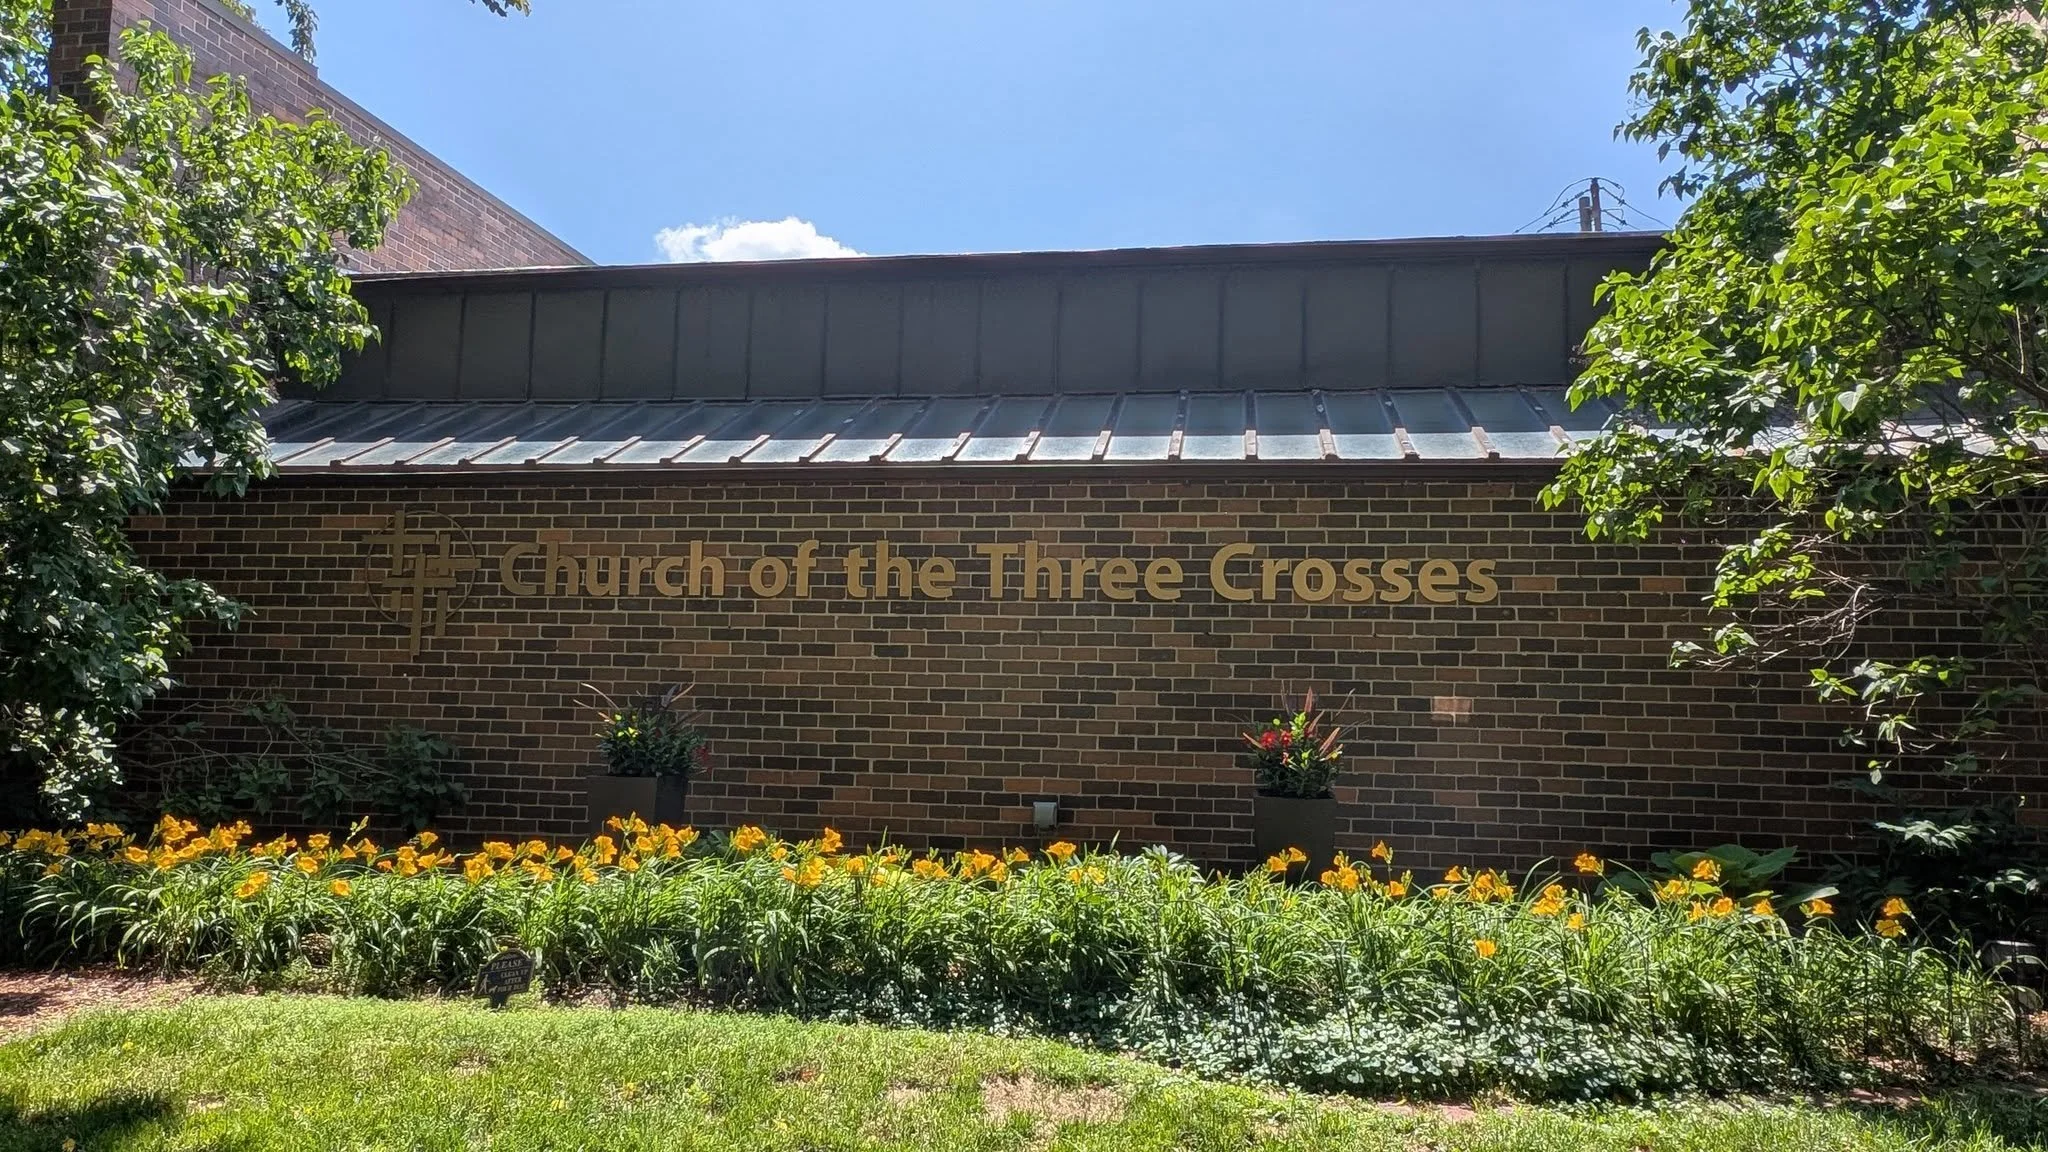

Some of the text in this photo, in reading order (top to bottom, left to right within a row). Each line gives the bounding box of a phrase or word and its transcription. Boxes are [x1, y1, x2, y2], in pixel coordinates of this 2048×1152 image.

[498, 539, 1499, 603] Church of the Three Crosses
[491, 959, 524, 970] PLEASE
[504, 977, 522, 985] AFTER
